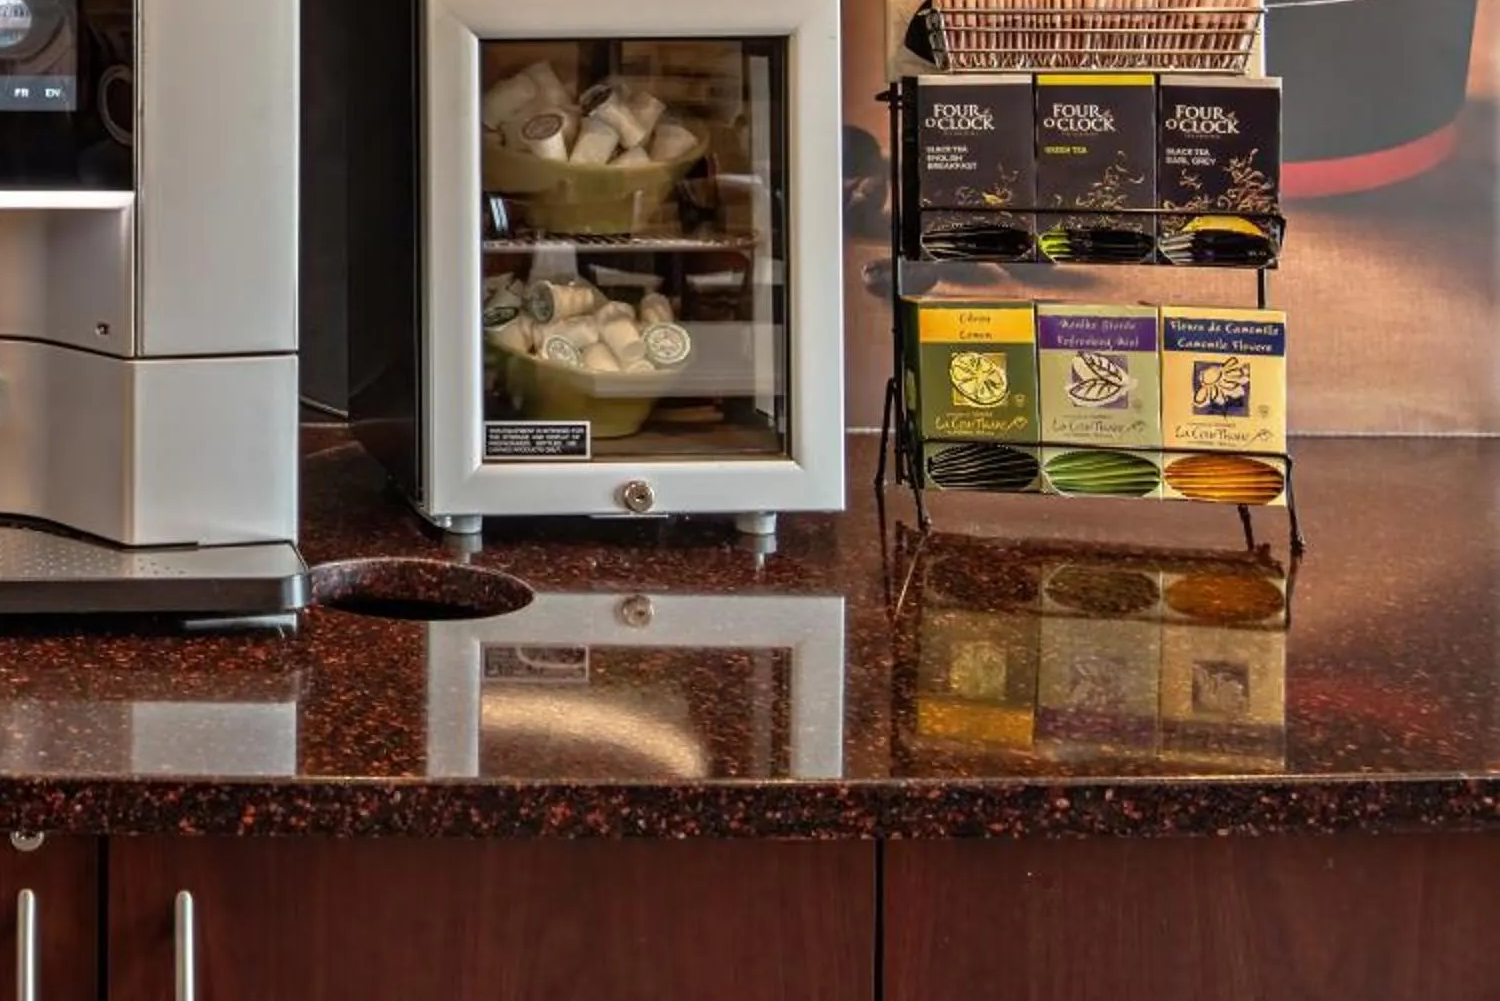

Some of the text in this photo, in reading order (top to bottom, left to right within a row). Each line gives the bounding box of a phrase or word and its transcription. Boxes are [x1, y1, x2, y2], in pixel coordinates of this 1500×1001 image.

[14, 88, 61, 98] FR EN
[933, 103, 981, 118] FOUR
[1053, 103, 1102, 118] FOUR
[1175, 104, 1225, 119] FOUR
[1207, 321, 1221, 332] de
